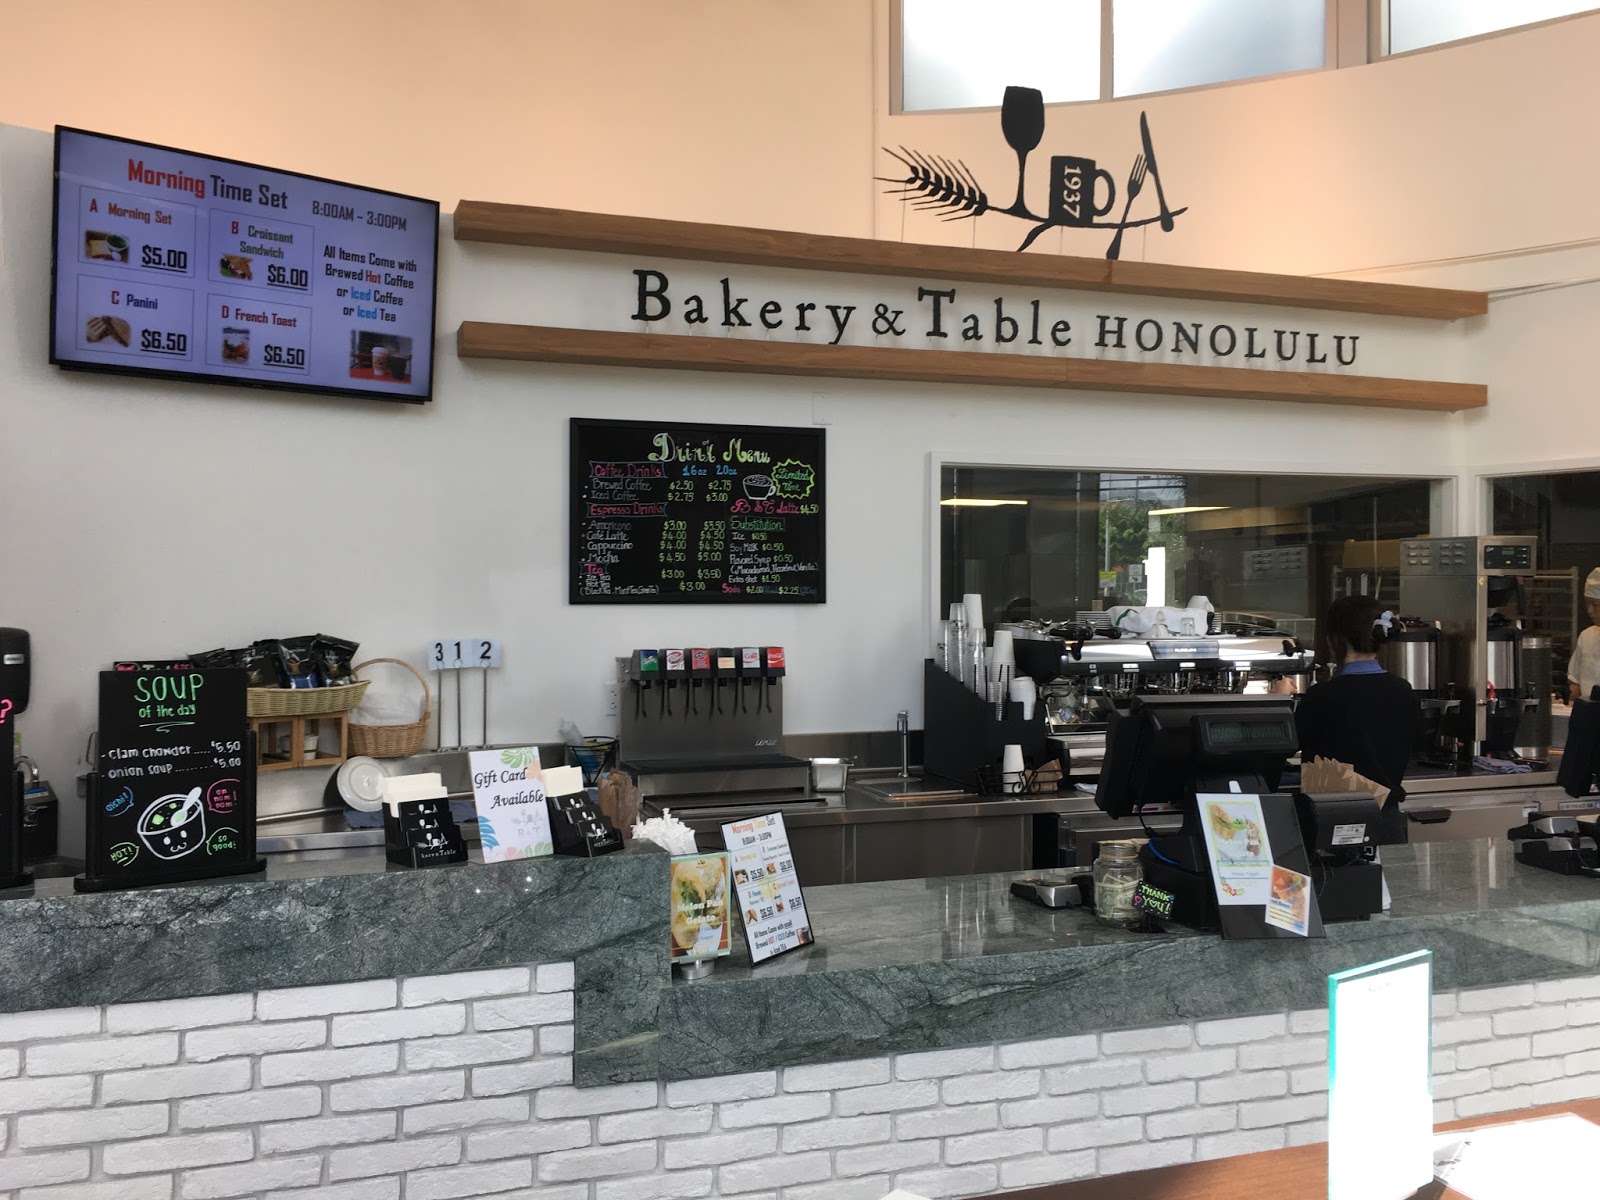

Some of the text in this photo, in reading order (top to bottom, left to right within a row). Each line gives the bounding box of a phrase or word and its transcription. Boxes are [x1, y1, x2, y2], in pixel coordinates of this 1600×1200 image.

[128, 158, 288, 210] Morning Time Set
[1063, 165, 1082, 219] 1937
[89, 198, 172, 225] A Morning Set
[312, 200, 407, 232] 8:00AM 3:00PM
[231, 220, 294, 244] B Croissant
[142, 244, 187, 271] $5.00
[240, 241, 284, 259] Sandwich
[323, 244, 417, 273] All Items Come with
[267, 263, 308, 288] $6.00
[325, 263, 414, 289] Brewed Hot Coffee
[111, 291, 159, 310] C Panini
[336, 286, 404, 306] or Iced Coffee
[221, 305, 297, 328] D French Toast
[343, 305, 397, 322] or Iced Tea
[631, 269, 1360, 366] Bakery & Table HONOLULU
[141, 328, 187, 353] $6.50
[264, 344, 304, 366] $6.50
[723, 438, 771, 464] Menu
[594, 463, 738, 477] Coffee Drinks 16oz 20oz
[776, 468, 810, 480] Limited
[592, 478, 732, 491] Brewed Coffee $2.50 $2.75
[591, 490, 729, 502] Iced Coffee $2.75 $3.00
[590, 502, 663, 518] Espresso Drinks
[800, 504, 819, 516] $4.50
[588, 520, 726, 531] Americano $3.00 $3.50
[730, 515, 783, 530] Substitution
[605, 530, 629, 541] Latte
[662, 531, 687, 541] $4.00
[700, 531, 726, 541] $4.50
[731, 532, 768, 541] Ice $0.50
[587, 540, 725, 554] Cappuccino $4.00 $4.50
[762, 543, 784, 552] $0.50
[587, 551, 722, 563] Mocha $4.50 $5.00
[773, 554, 794, 563] $0.50
[584, 563, 604, 574] Tea
[661, 568, 685, 579] $3.00
[697, 568, 722, 579] $3.50
[680, 580, 706, 592] $3.00
[761, 574, 780, 583] $1.50
[722, 583, 741, 593] Soda
[746, 585, 764, 594] $2.00
[778, 586, 800, 595] $2.25
[435, 642, 444, 661] 3
[454, 641, 461, 659] 1
[480, 641, 491, 660] 2
[134, 673, 204, 702] SOUP
[138, 704, 197, 718] of the day
[211, 740, 241, 753] $5.50
[474, 767, 528, 788] Gift Card
[490, 789, 544, 810] Available
[731, 823, 754, 834] Morning
[1141, 885, 1169, 901] THANK
[678, 899, 724, 911] Melon Pan
[686, 915, 716, 925] Gelato
